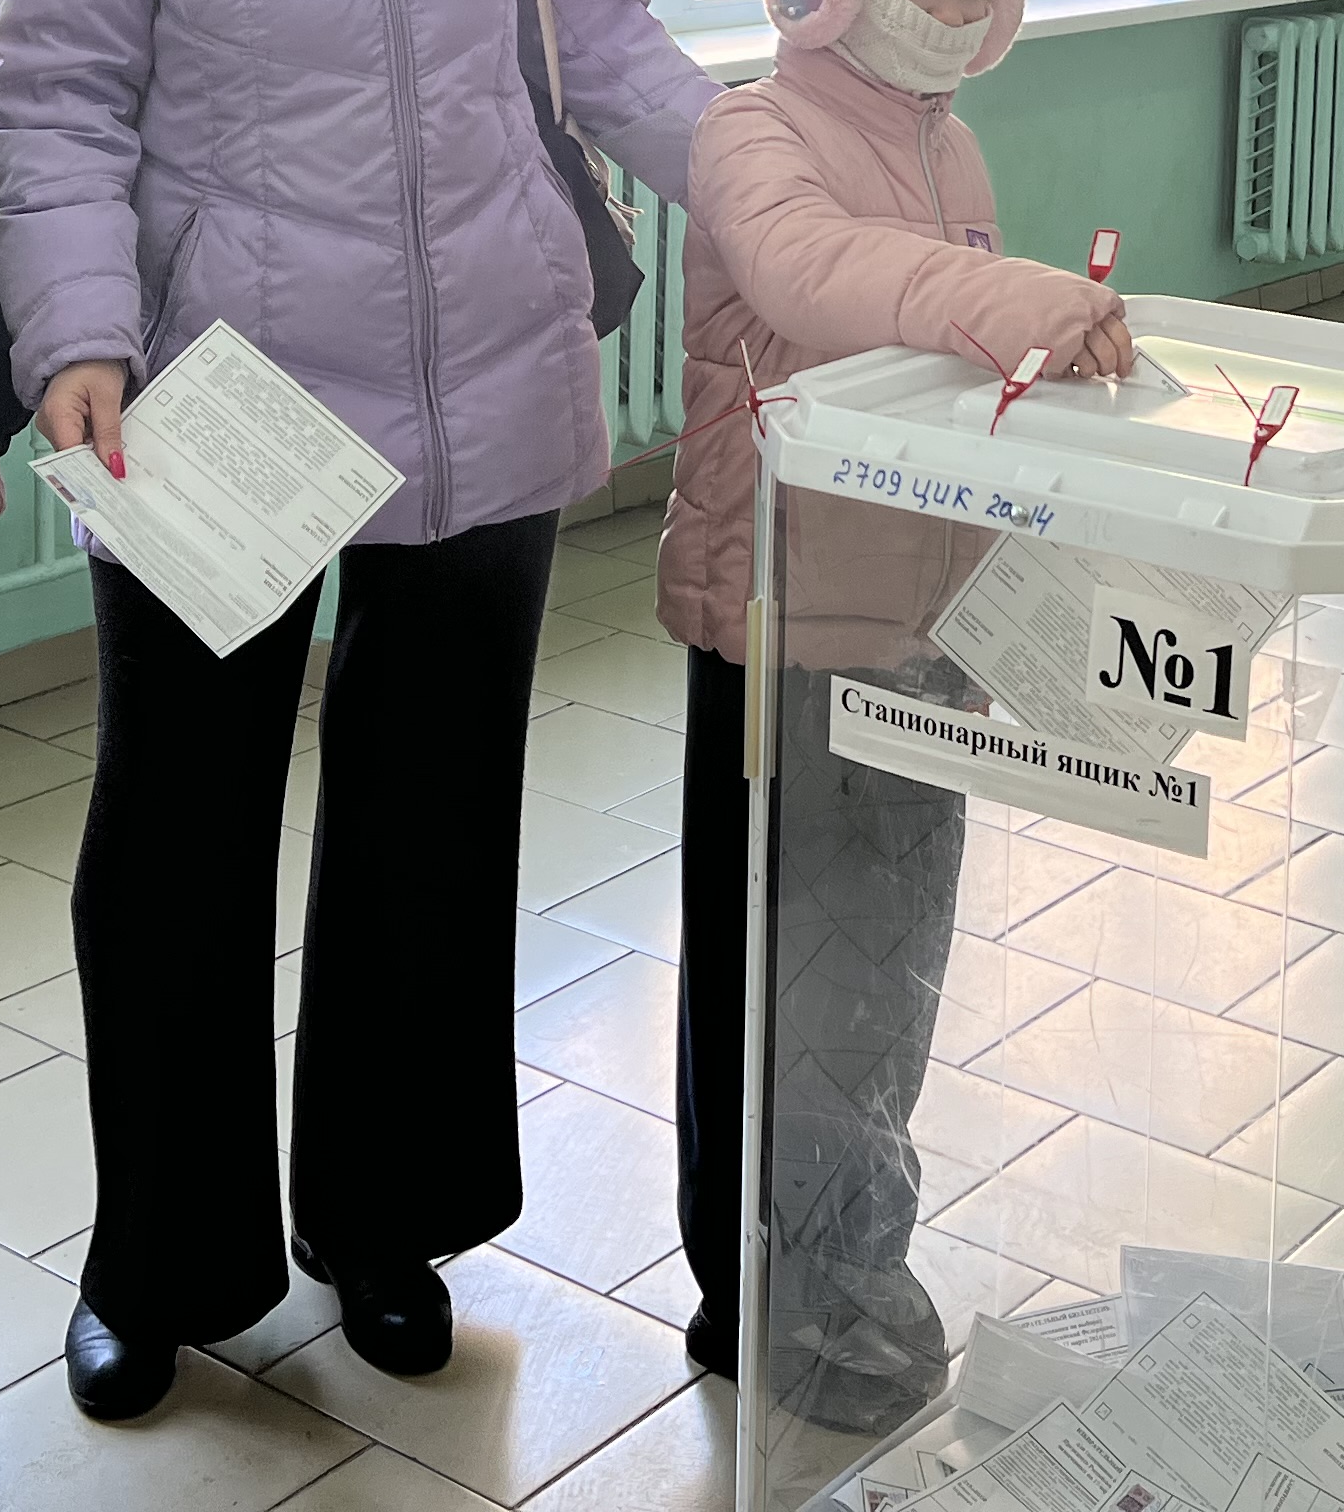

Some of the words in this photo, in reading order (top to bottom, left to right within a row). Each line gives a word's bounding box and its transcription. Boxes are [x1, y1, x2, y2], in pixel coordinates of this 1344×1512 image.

[833, 458, 902, 497] 2709
[1098, 615, 1240, 721] №1
[841, 687, 1049, 769] Стационарный
[1056, 752, 1142, 793] ящик
[1148, 770, 1200, 809] №1
